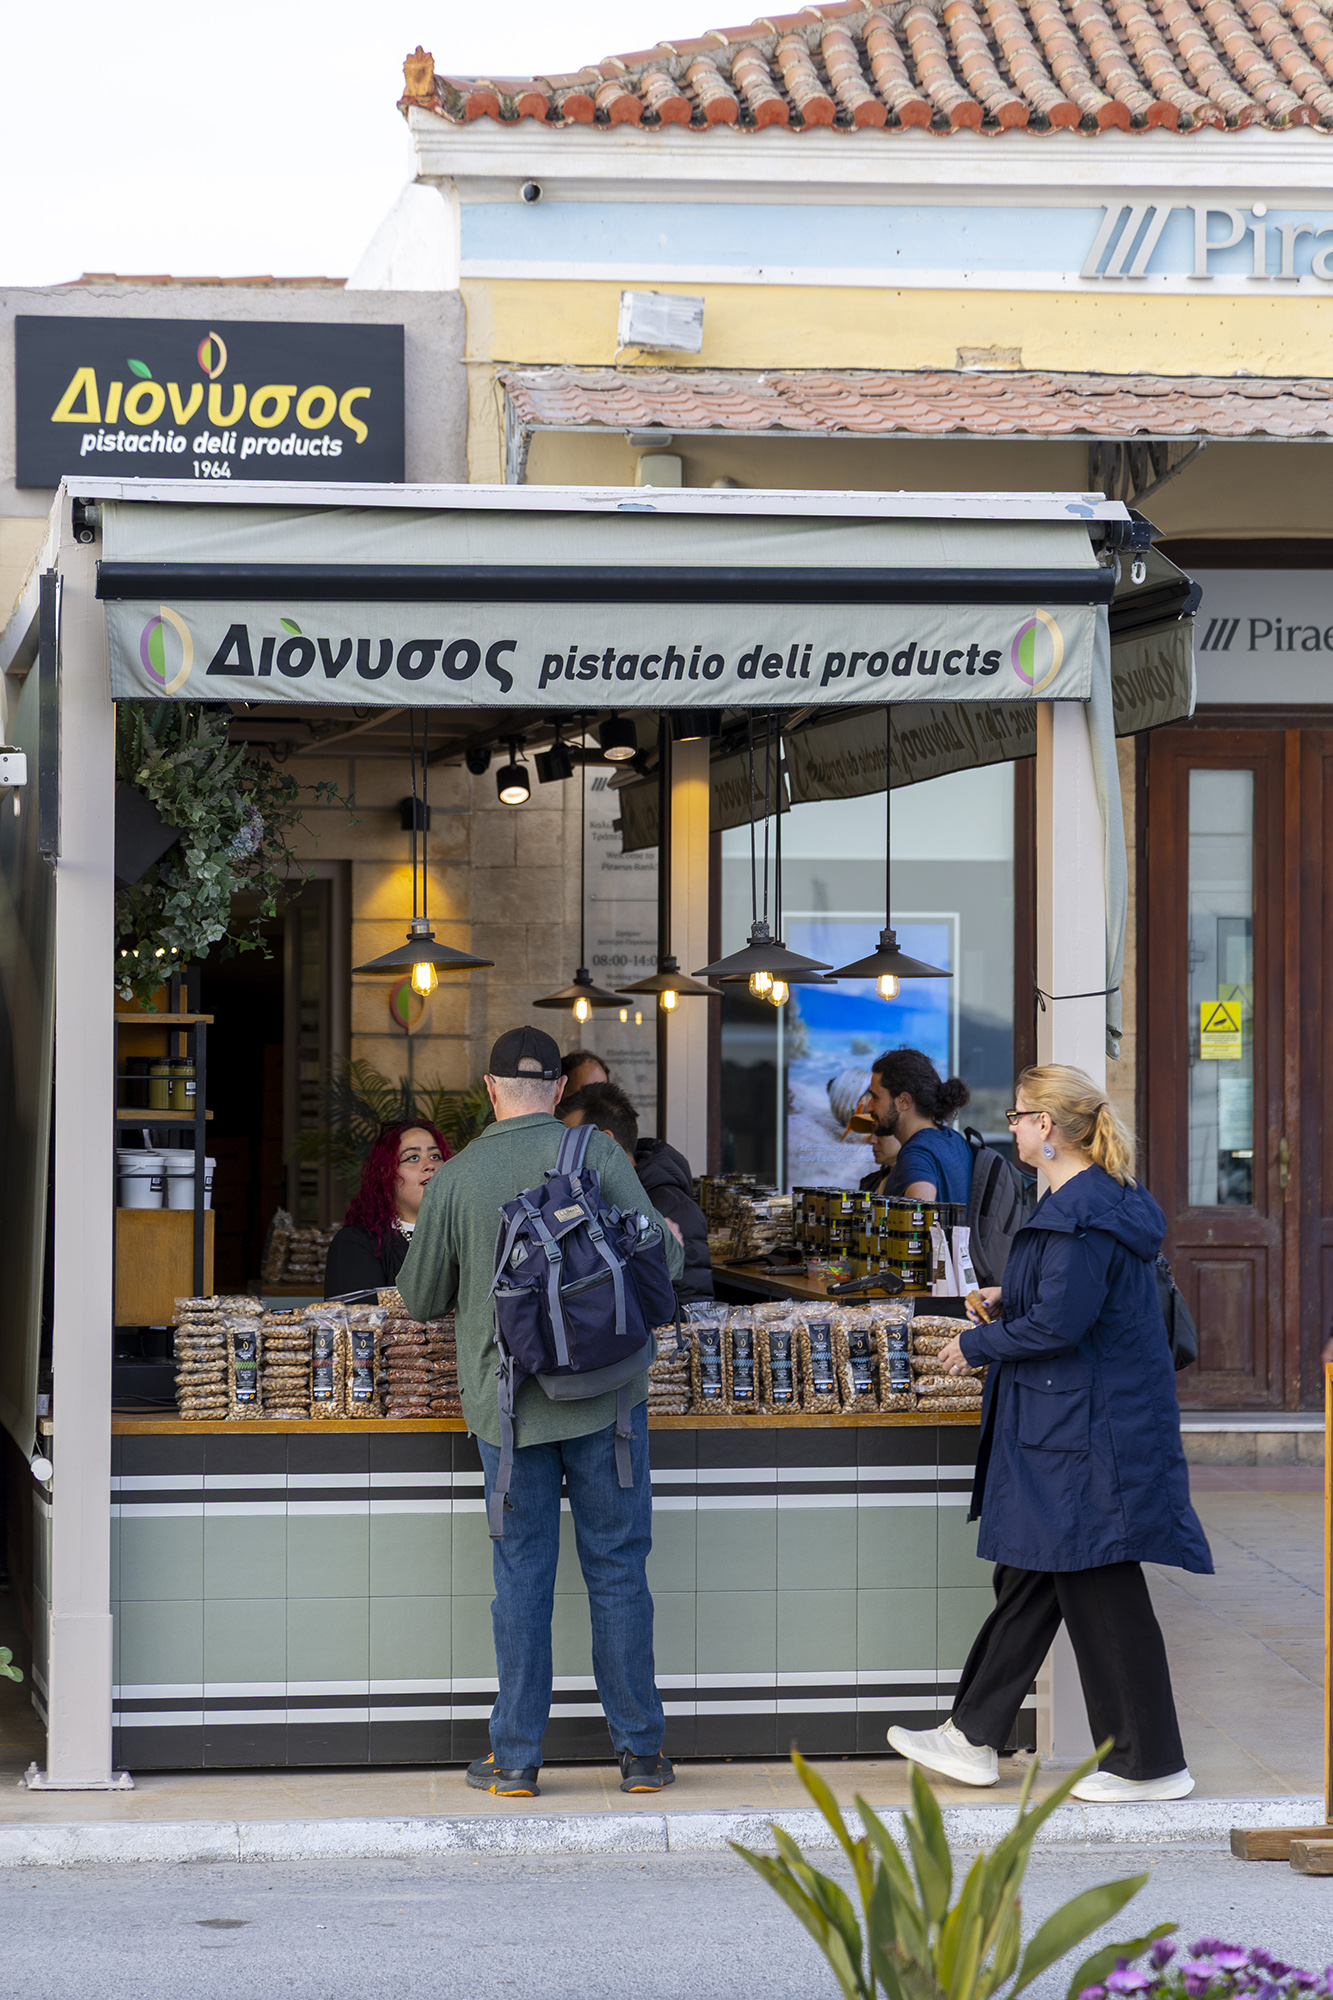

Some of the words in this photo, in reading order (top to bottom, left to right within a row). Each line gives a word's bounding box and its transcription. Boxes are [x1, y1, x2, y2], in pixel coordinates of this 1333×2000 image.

[80, 429, 187, 457] pistachio
[192, 430, 236, 456] deli
[240, 432, 343, 460] products
[193, 460, 232, 479] 1964
[538, 643, 725, 690] pistachio
[736, 643, 814, 681] deli
[820, 642, 1003, 688] products
